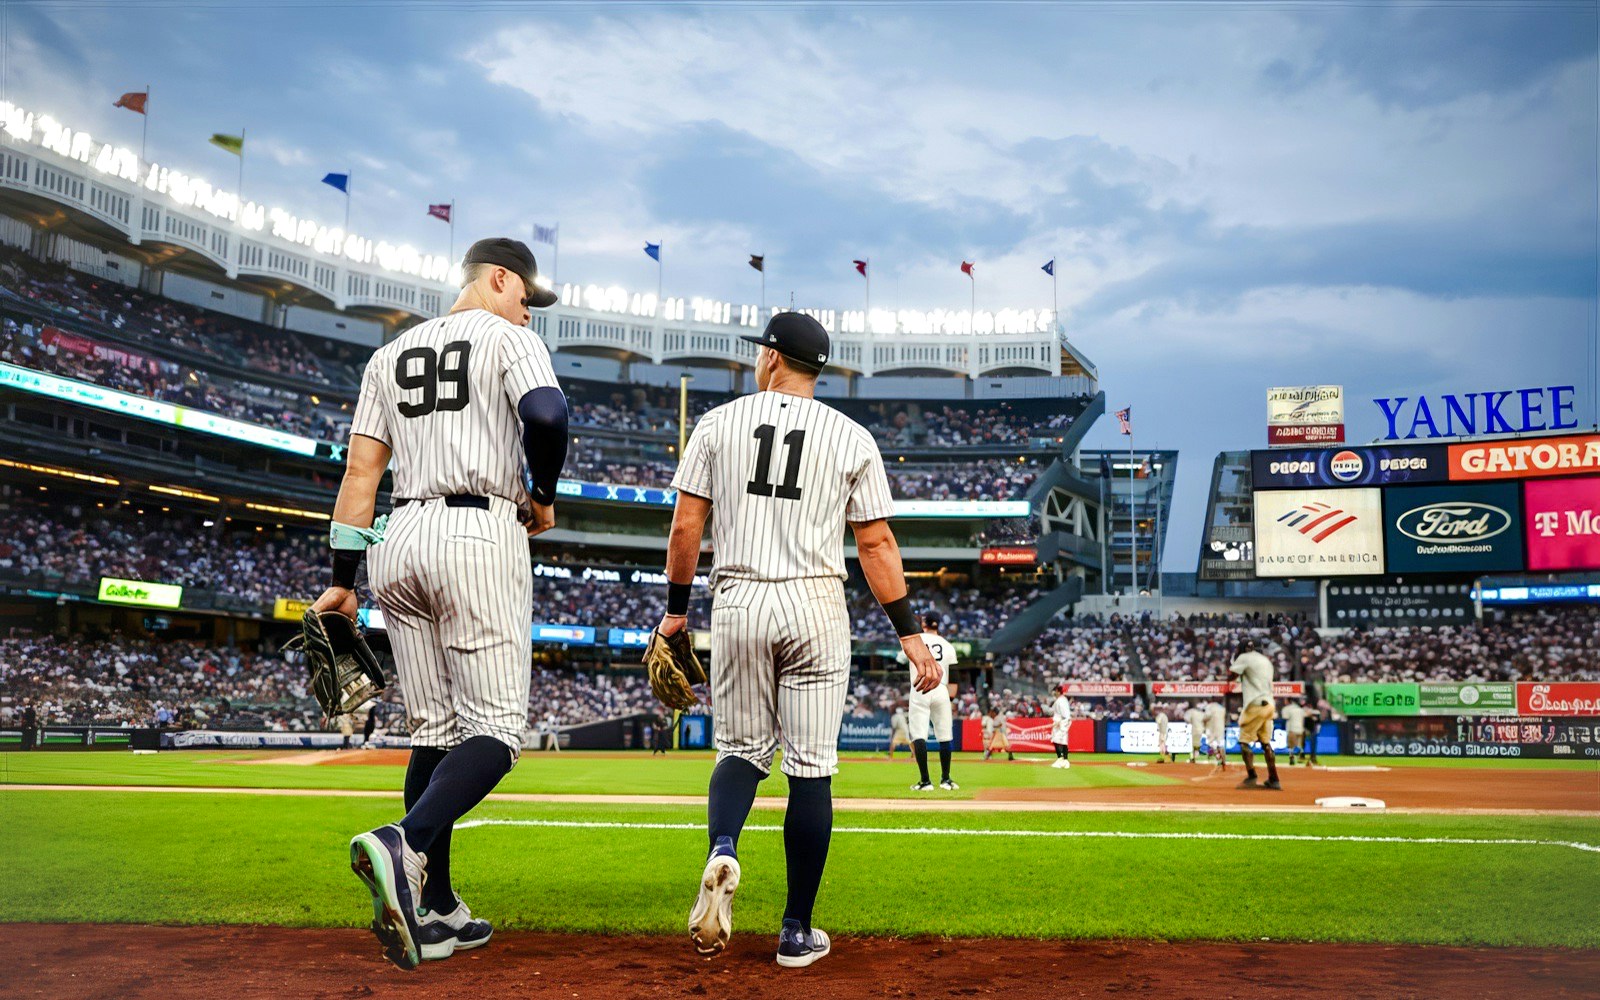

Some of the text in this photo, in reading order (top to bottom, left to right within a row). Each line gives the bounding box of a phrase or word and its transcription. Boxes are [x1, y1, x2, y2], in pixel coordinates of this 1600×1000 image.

[396, 340, 472, 418] 99
[1373, 386, 1577, 439] YANKEE
[747, 423, 805, 500] 11
[1461, 441, 1600, 473] GATORA
[1416, 508, 1490, 536] Ford
